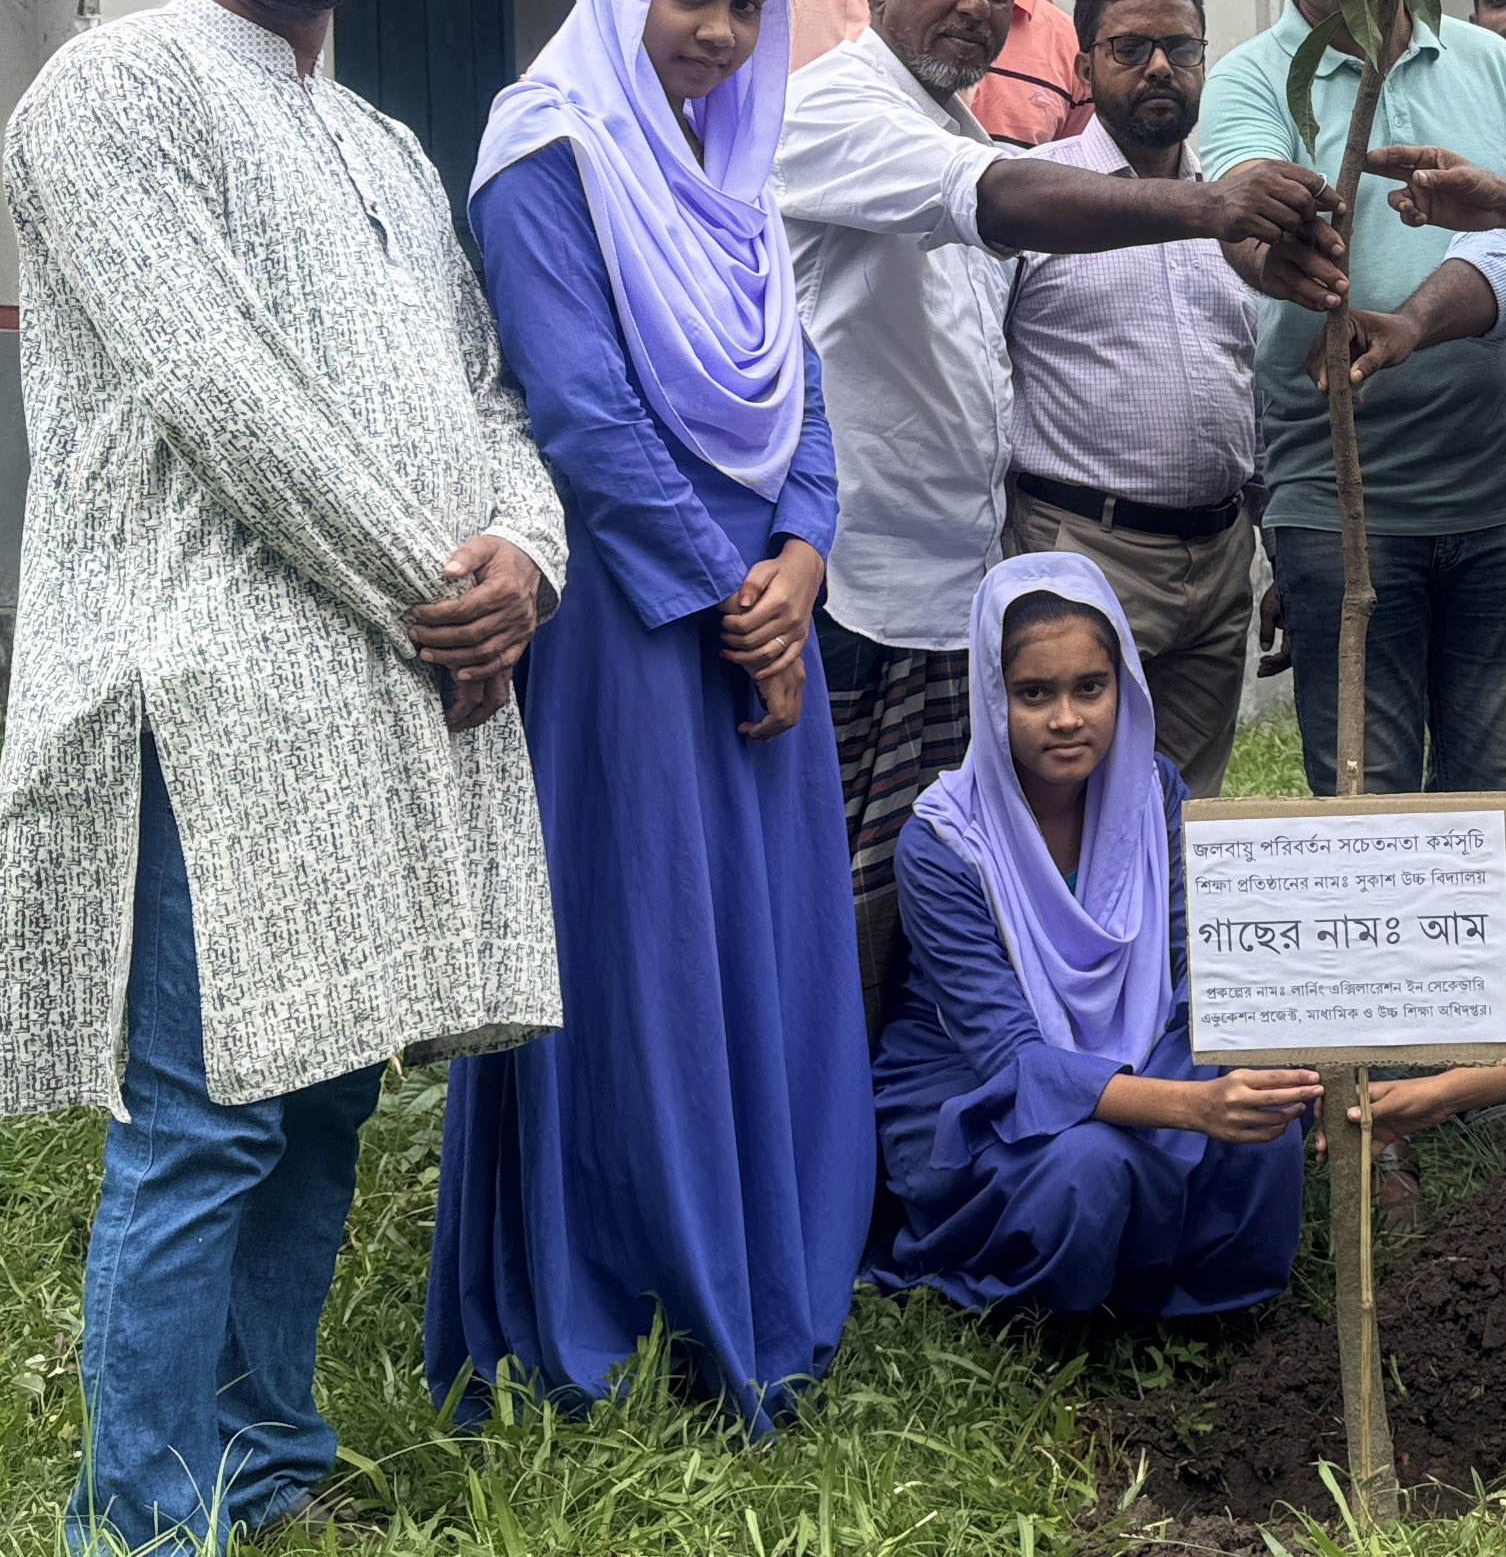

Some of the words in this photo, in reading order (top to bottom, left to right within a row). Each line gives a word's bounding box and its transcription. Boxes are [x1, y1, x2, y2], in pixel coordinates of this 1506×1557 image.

[1192, 840, 1256, 862] জলবায়ু
[1260, 833, 1332, 856] পরিবর্তন
[1337, 834, 1419, 854] সচেতনতা
[1425, 829, 1485, 855] কর্মসূচি
[1194, 876, 1232, 894] শিক্ষা
[1237, 874, 1309, 893] প্রতিষ্ঠানের
[1313, 875, 1349, 890] নামঃ
[1355, 873, 1396, 893] সুকাশ
[1401, 869, 1426, 886] উচ্চ
[1430, 868, 1486, 886] বিদ্যালয়
[1198, 917, 1303, 955] গাছের
[1313, 914, 1401, 950] নামঃ
[1417, 910, 1489, 947] আম
[1290, 981, 1325, 997] লার্নিং
[1405, 979, 1424, 995] ইন
[1428, 976, 1485, 993] সেকেন্ডারি
[1201, 1011, 1256, 1028] এডুকেশন
[1306, 1005, 1359, 1021] মাধ্যমিক
[1363, 1008, 1374, 1019] ও
[1378, 1004, 1399, 1018] উচ্চ
[1403, 1003, 1434, 1019] শিক্ষা
